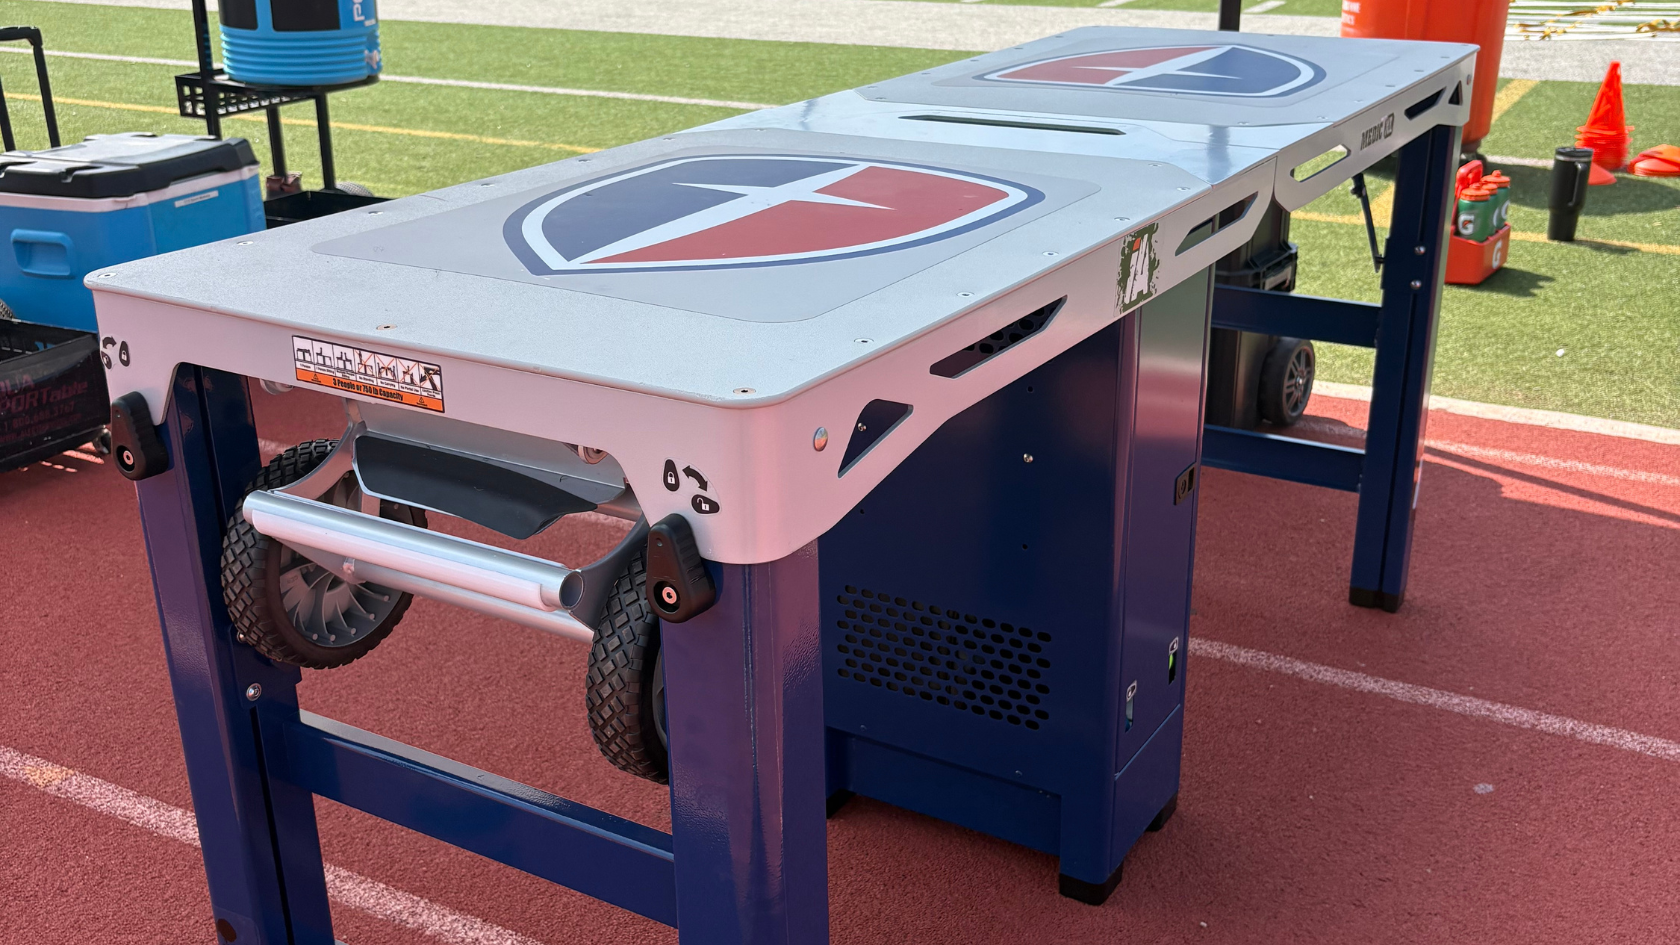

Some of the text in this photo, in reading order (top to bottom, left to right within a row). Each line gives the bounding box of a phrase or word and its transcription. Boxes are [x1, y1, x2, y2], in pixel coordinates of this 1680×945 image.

[1458, 213, 1475, 236] G
[1492, 240, 1503, 269] G
[332, 376, 337, 386] 3
[337, 378, 355, 391] People
[355, 383, 362, 392] or
[362, 382, 373, 394] 750
[373, 385, 379, 395] lb
[379, 387, 404, 402] Capacity
